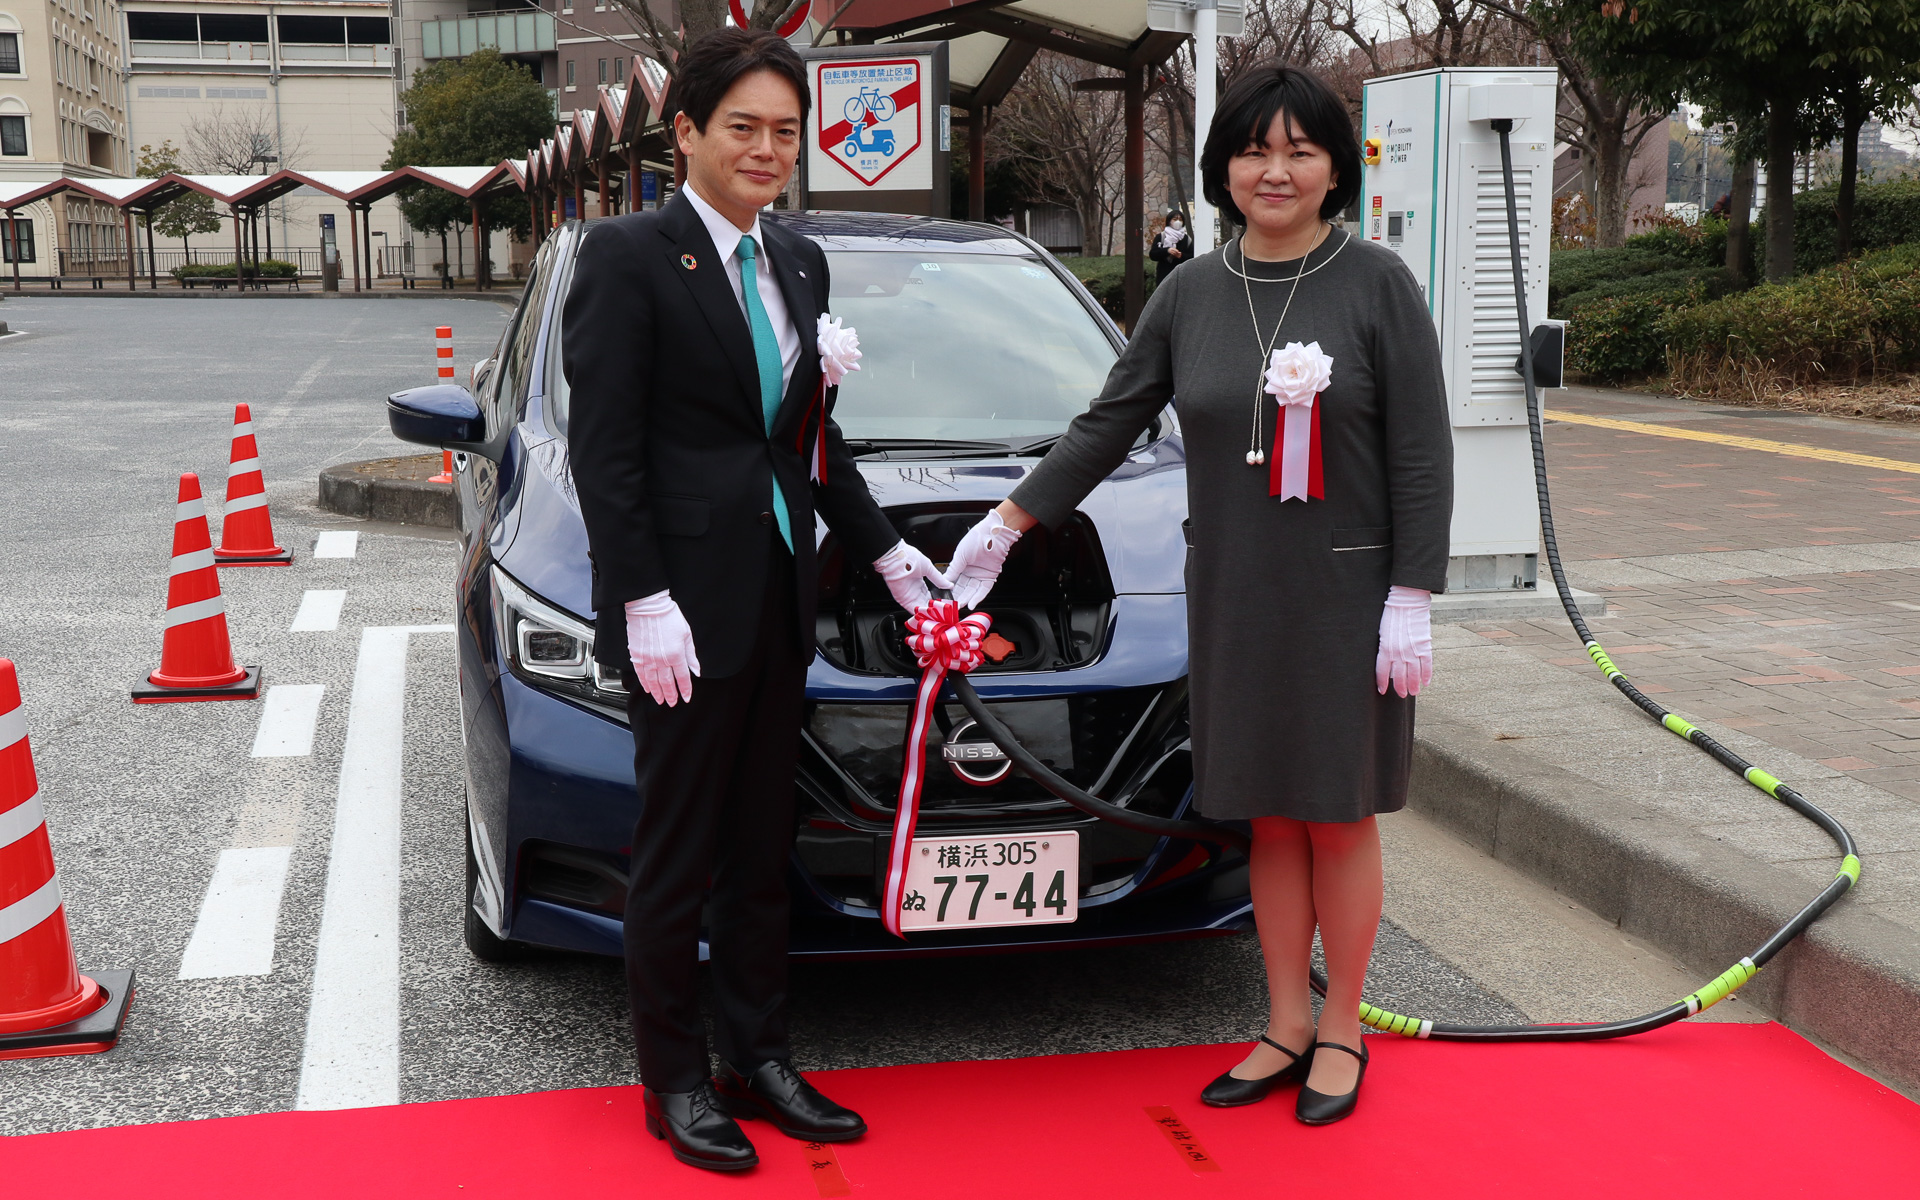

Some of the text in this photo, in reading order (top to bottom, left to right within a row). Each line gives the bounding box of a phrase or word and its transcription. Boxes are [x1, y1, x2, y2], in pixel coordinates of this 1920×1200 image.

[824, 67, 913, 80] 自転車等放置禁止区域
[1390, 154, 1407, 163] POWER
[943, 747, 1005, 758] NISSA
[933, 869, 1067, 922] 77-44
